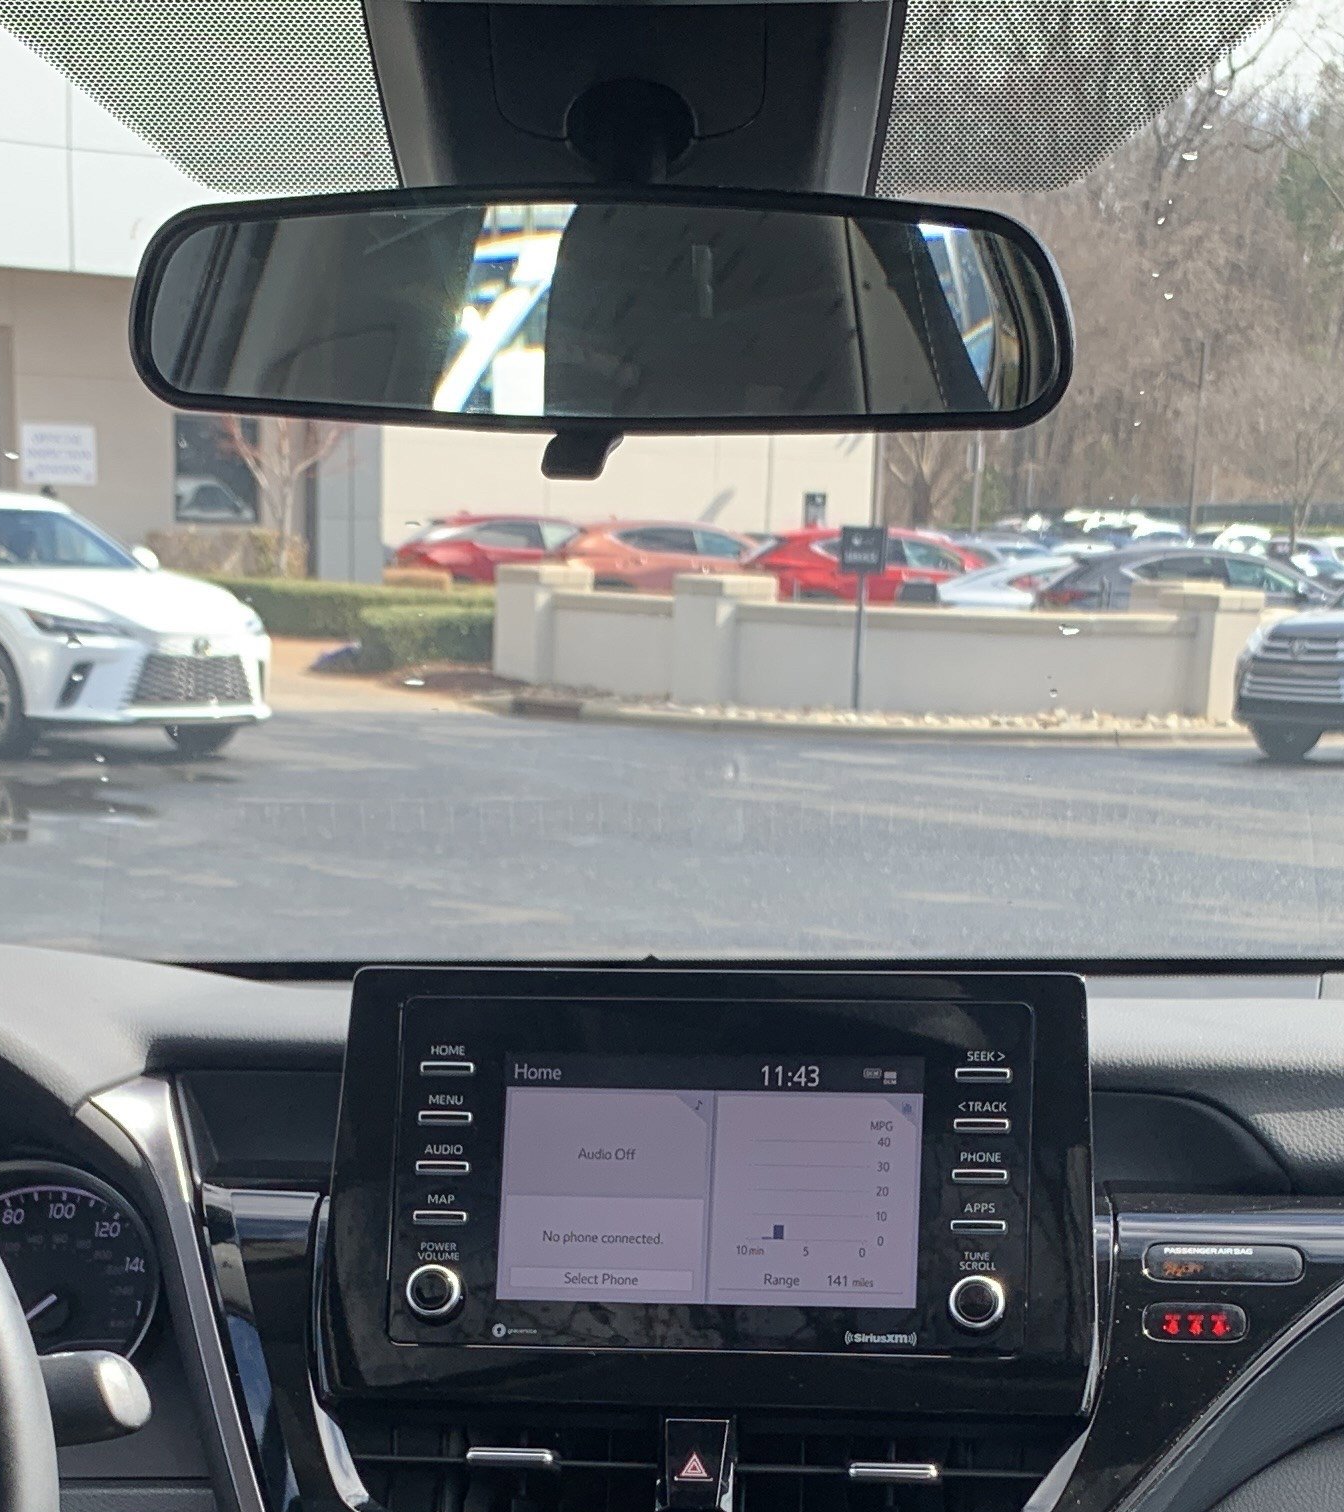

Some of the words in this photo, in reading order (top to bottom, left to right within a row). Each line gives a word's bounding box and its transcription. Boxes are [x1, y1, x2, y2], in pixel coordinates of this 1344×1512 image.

[430, 1045, 466, 1056] HOME
[967, 1051, 995, 1061] SEEK
[514, 1063, 562, 1081] Home
[761, 1065, 820, 1087] 11:43
[428, 1094, 464, 1105] MENU
[968, 1101, 1007, 1113] TRACK
[870, 1121, 894, 1132] MPG
[877, 1136, 891, 1147] 40
[424, 1144, 464, 1155] AUDIO
[577, 1148, 612, 1160] Audio
[614, 1148, 638, 1160] Off
[960, 1152, 1002, 1163] PHONE
[877, 1161, 890, 1173] 30
[876, 1186, 889, 1198] 20
[427, 1194, 456, 1204] MAP
[48, 1203, 76, 1220] 100
[964, 1203, 996, 1214] APPS
[2, 1208, 25, 1225] 80
[876, 1211, 888, 1222] 10
[94, 1221, 122, 1238] 120
[542, 1230, 560, 1243] No
[562, 1231, 599, 1245] phone
[601, 1232, 664, 1245] connected.
[877, 1235, 885, 1247] 0
[420, 1242, 457, 1251] POWER
[736, 1244, 748, 1256] 10
[802, 1246, 810, 1257] 5
[417, 1252, 460, 1261] VOLUME
[858, 1247, 866, 1258] 0
[964, 1251, 991, 1261] TUNE
[959, 1261, 996, 1271] SCROLL
[564, 1271, 599, 1285] Select
[601, 1272, 639, 1286] Phone
[763, 1273, 801, 1288] Range
[827, 1275, 848, 1287] 141
[852, 1278, 874, 1288] miles
